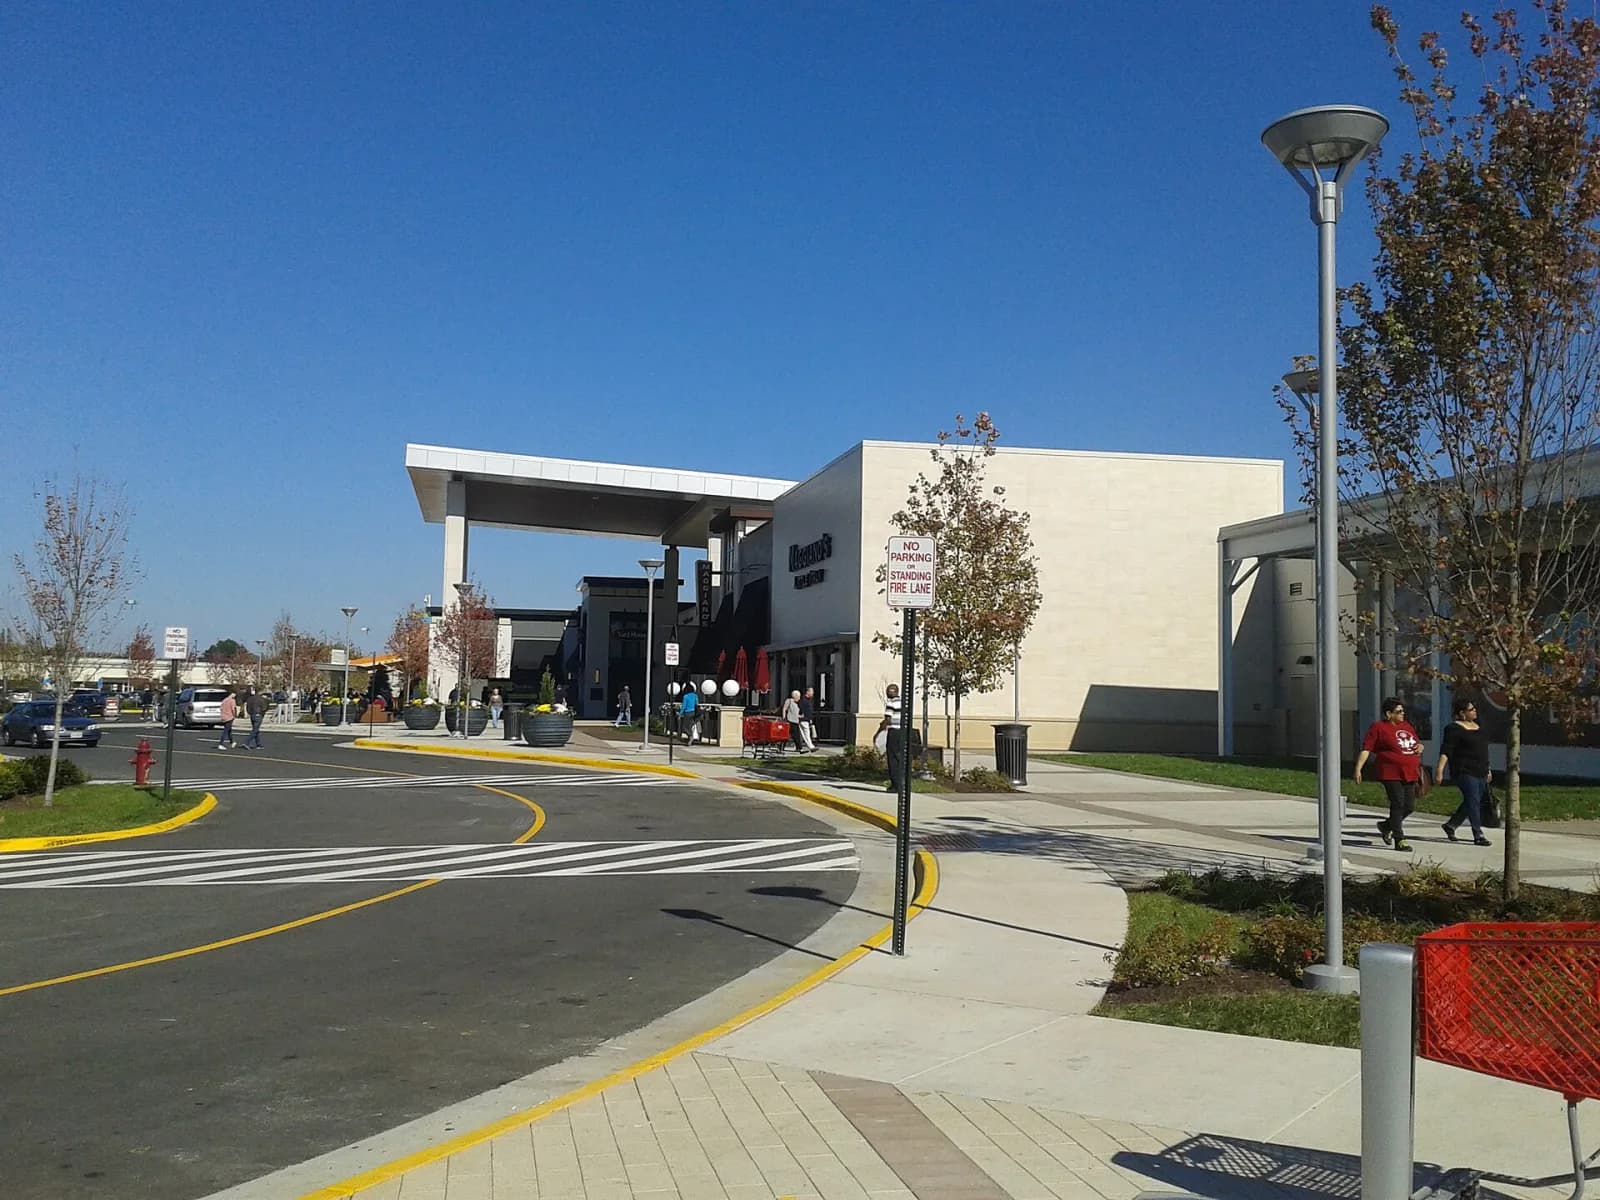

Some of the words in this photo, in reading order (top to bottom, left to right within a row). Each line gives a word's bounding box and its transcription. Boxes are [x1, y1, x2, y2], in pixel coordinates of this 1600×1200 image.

[903, 541, 920, 551] NO
[890, 552, 932, 562] PARKING
[890, 571, 932, 581] STANDING
[890, 582, 907, 593] FIRE
[910, 583, 931, 594] LANE
